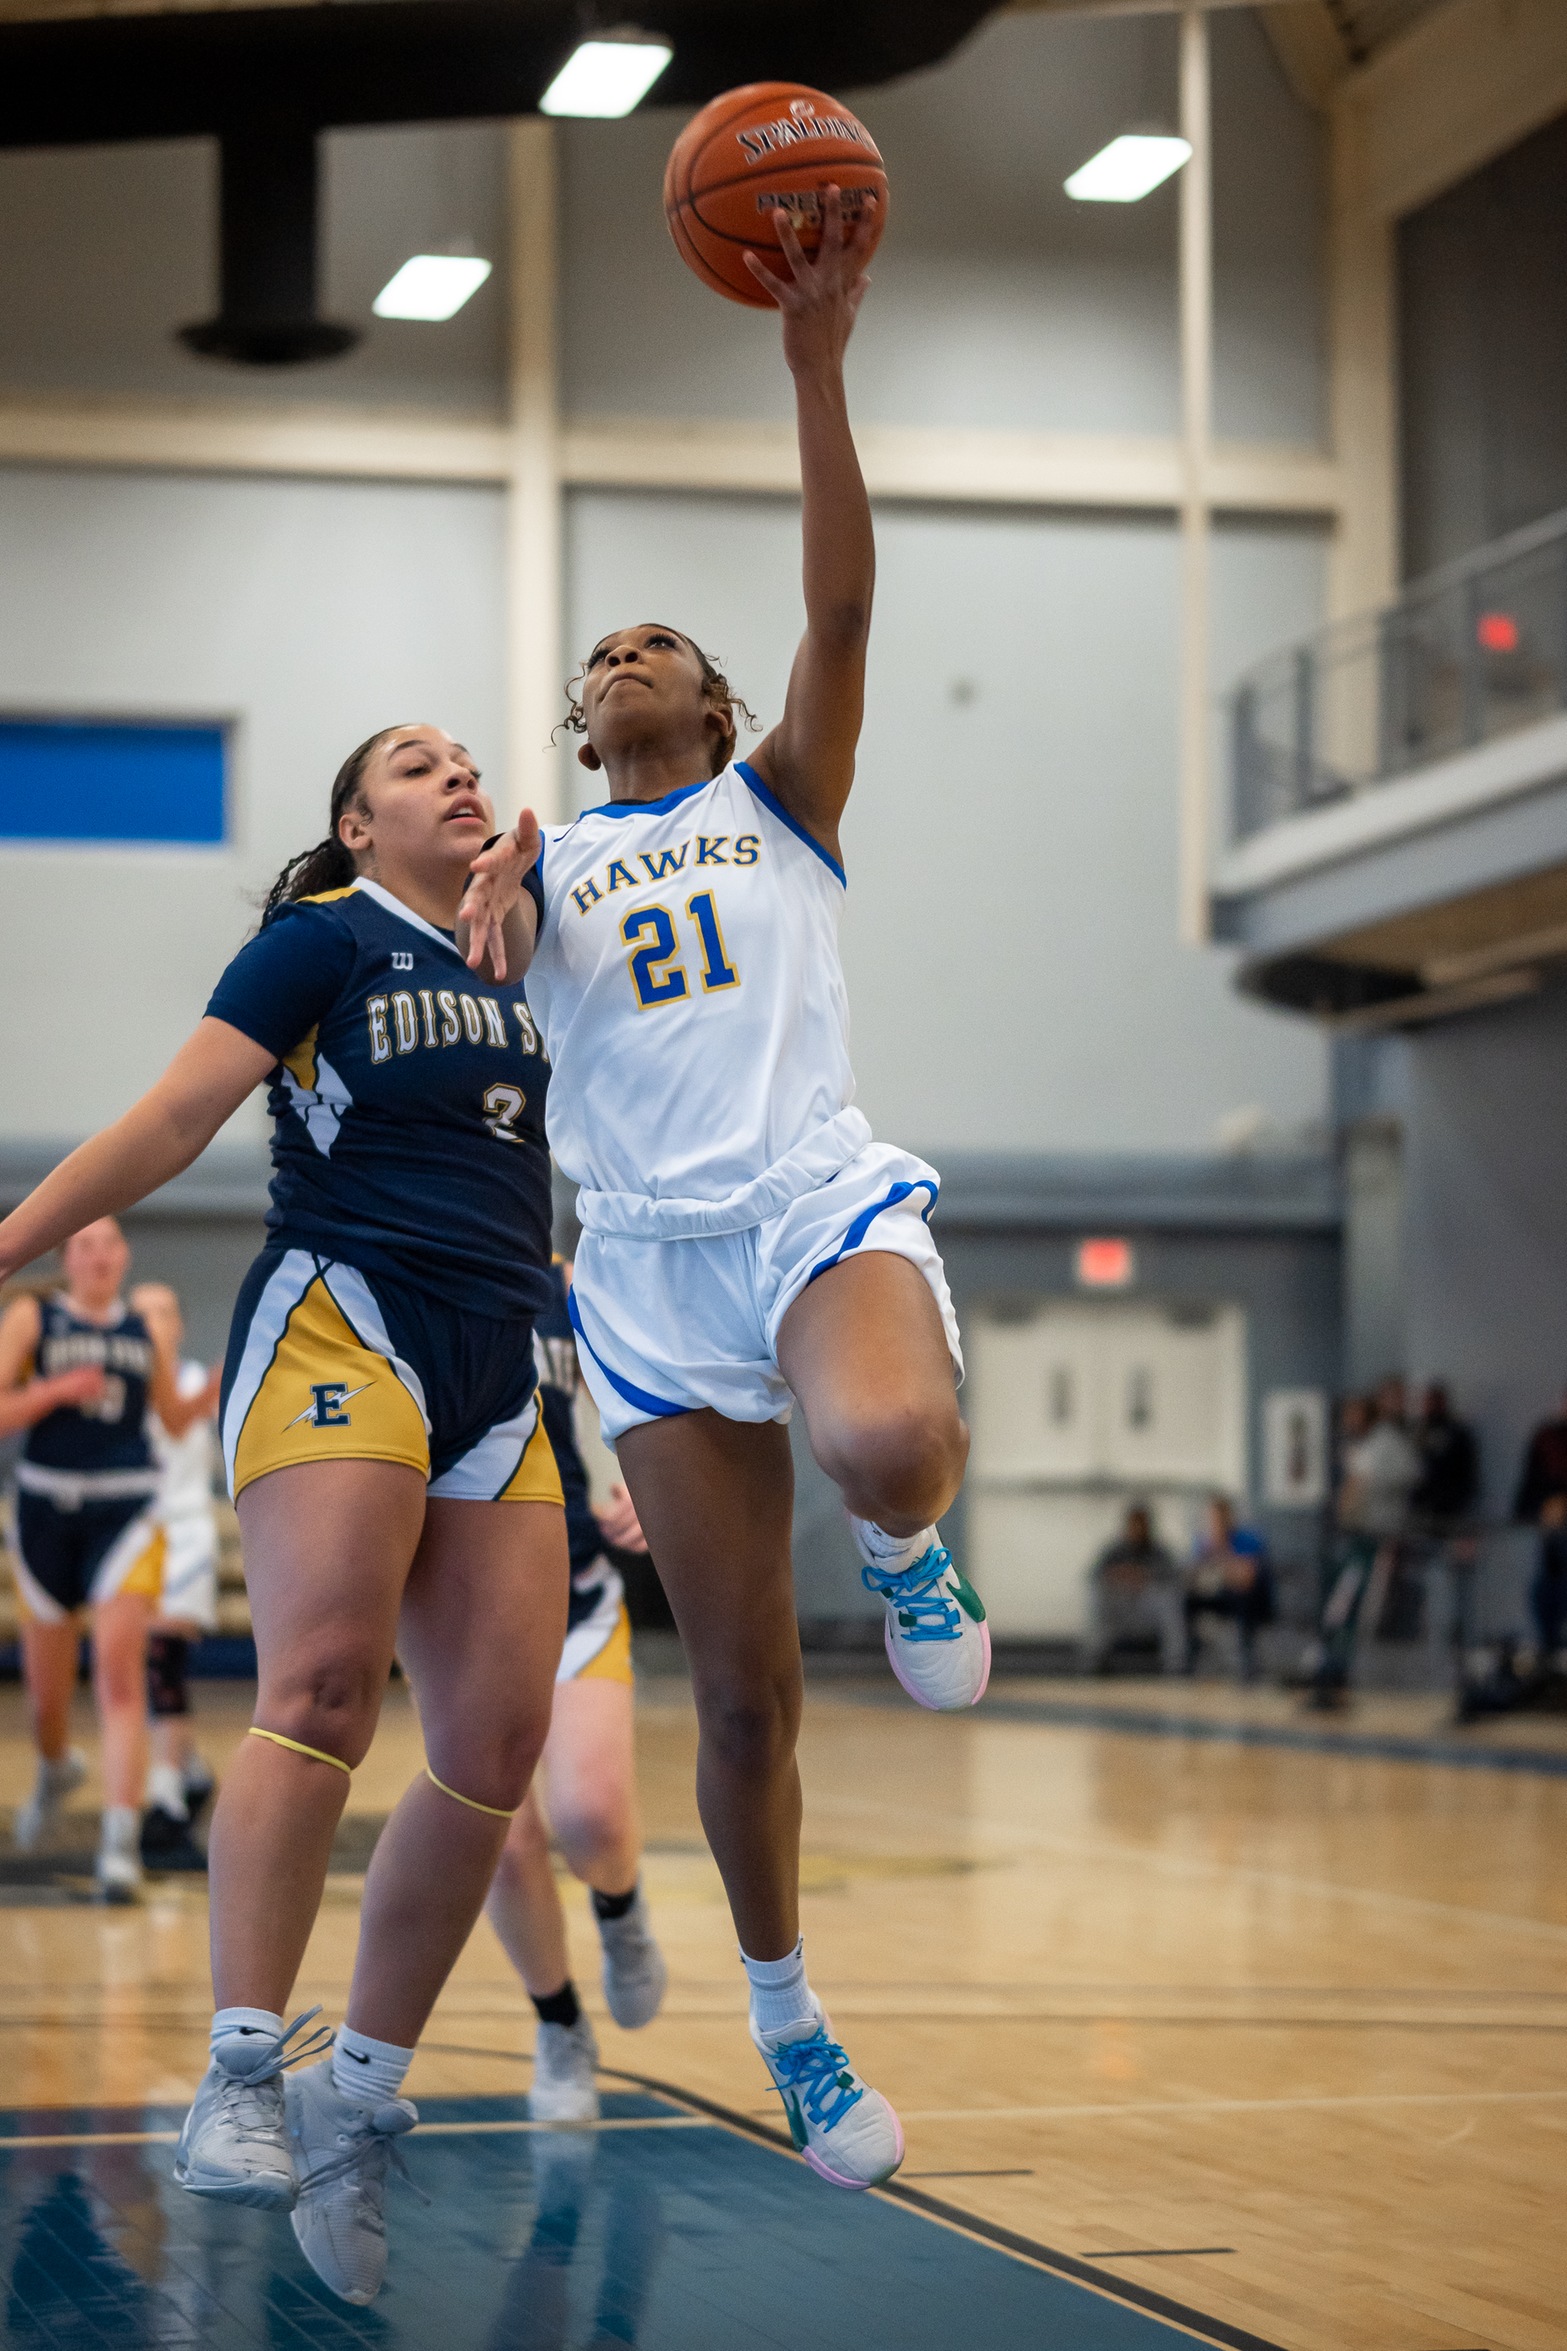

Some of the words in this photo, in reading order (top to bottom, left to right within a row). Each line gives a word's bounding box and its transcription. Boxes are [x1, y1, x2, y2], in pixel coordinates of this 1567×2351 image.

[569, 834, 762, 917] HAWKS
[618, 888, 742, 1012] 21
[366, 989, 510, 1066] EDISON
[512, 1002, 549, 1063] S
[482, 1082, 527, 1144] 2
[309, 1381, 352, 1429] E
